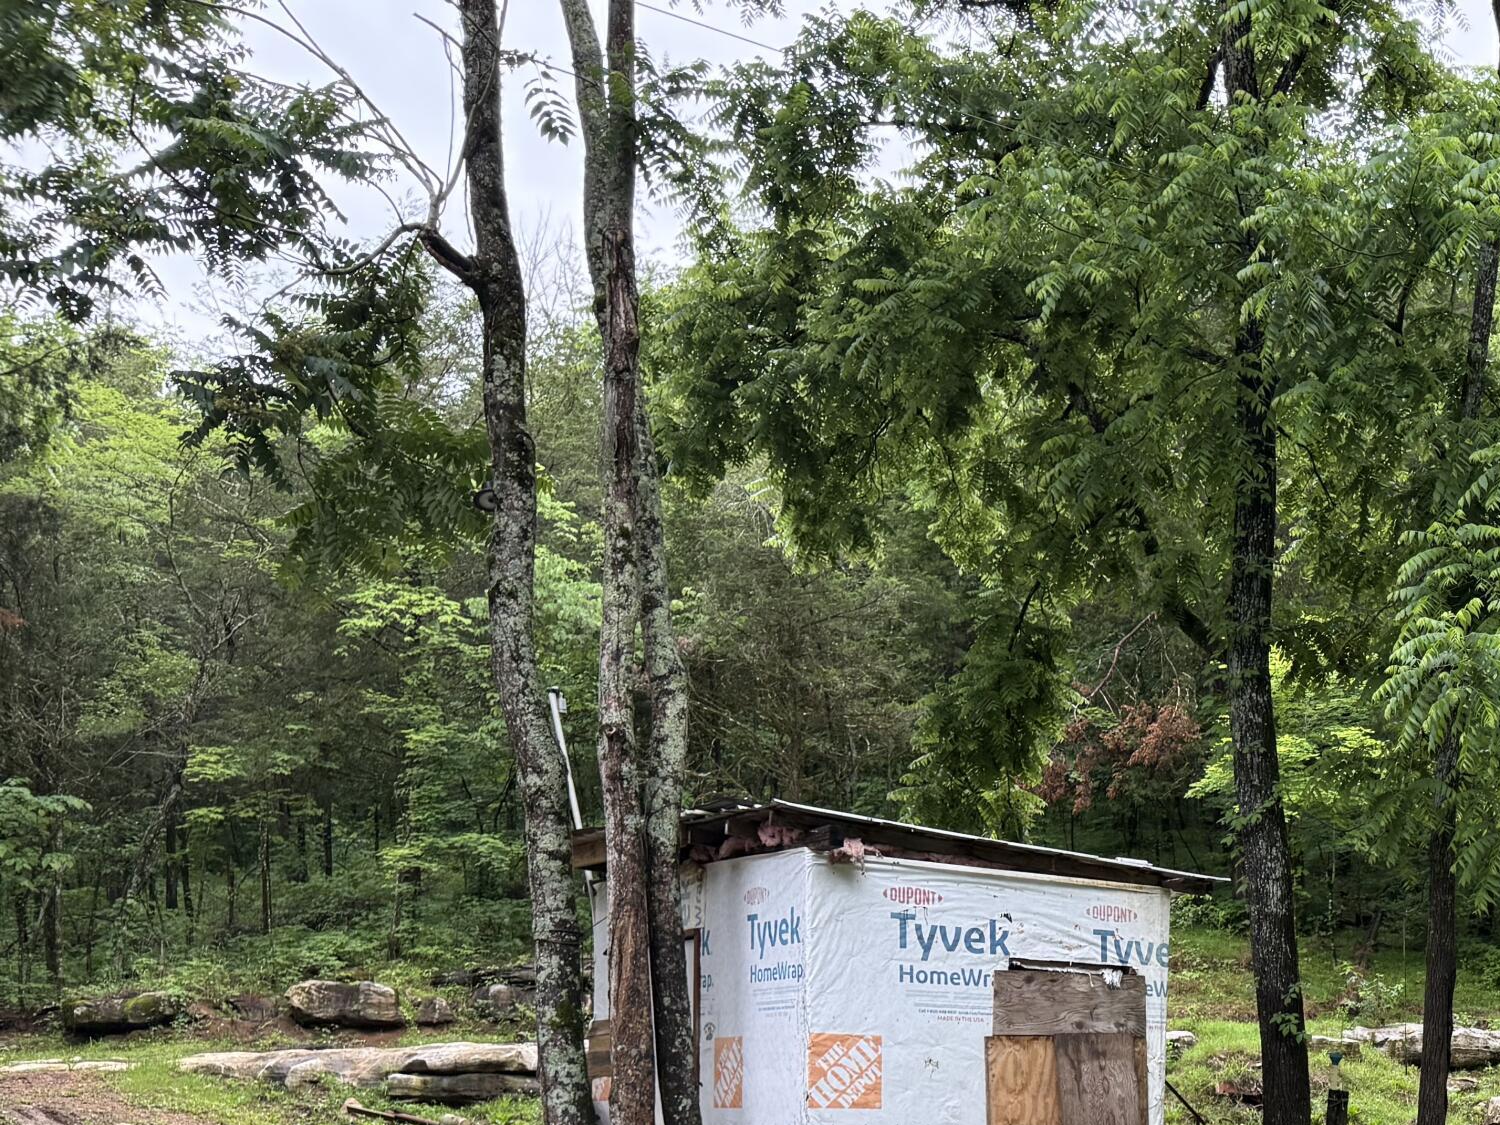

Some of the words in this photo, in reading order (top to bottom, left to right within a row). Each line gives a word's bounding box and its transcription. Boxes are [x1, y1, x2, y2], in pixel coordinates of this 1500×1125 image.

[890, 887, 937, 906] DUPONT
[1092, 905, 1133, 923] DUPONT
[747, 906, 801, 960] Tyvek
[890, 911, 1010, 961] Tyvek
[1092, 929, 1170, 968] Tyve
[750, 961, 804, 983] HomeWrap
[899, 964, 994, 988] HomeWr
[808, 1035, 882, 1108] HOME
[816, 1041, 847, 1071] THE
[836, 1062, 882, 1108] DEPOT
